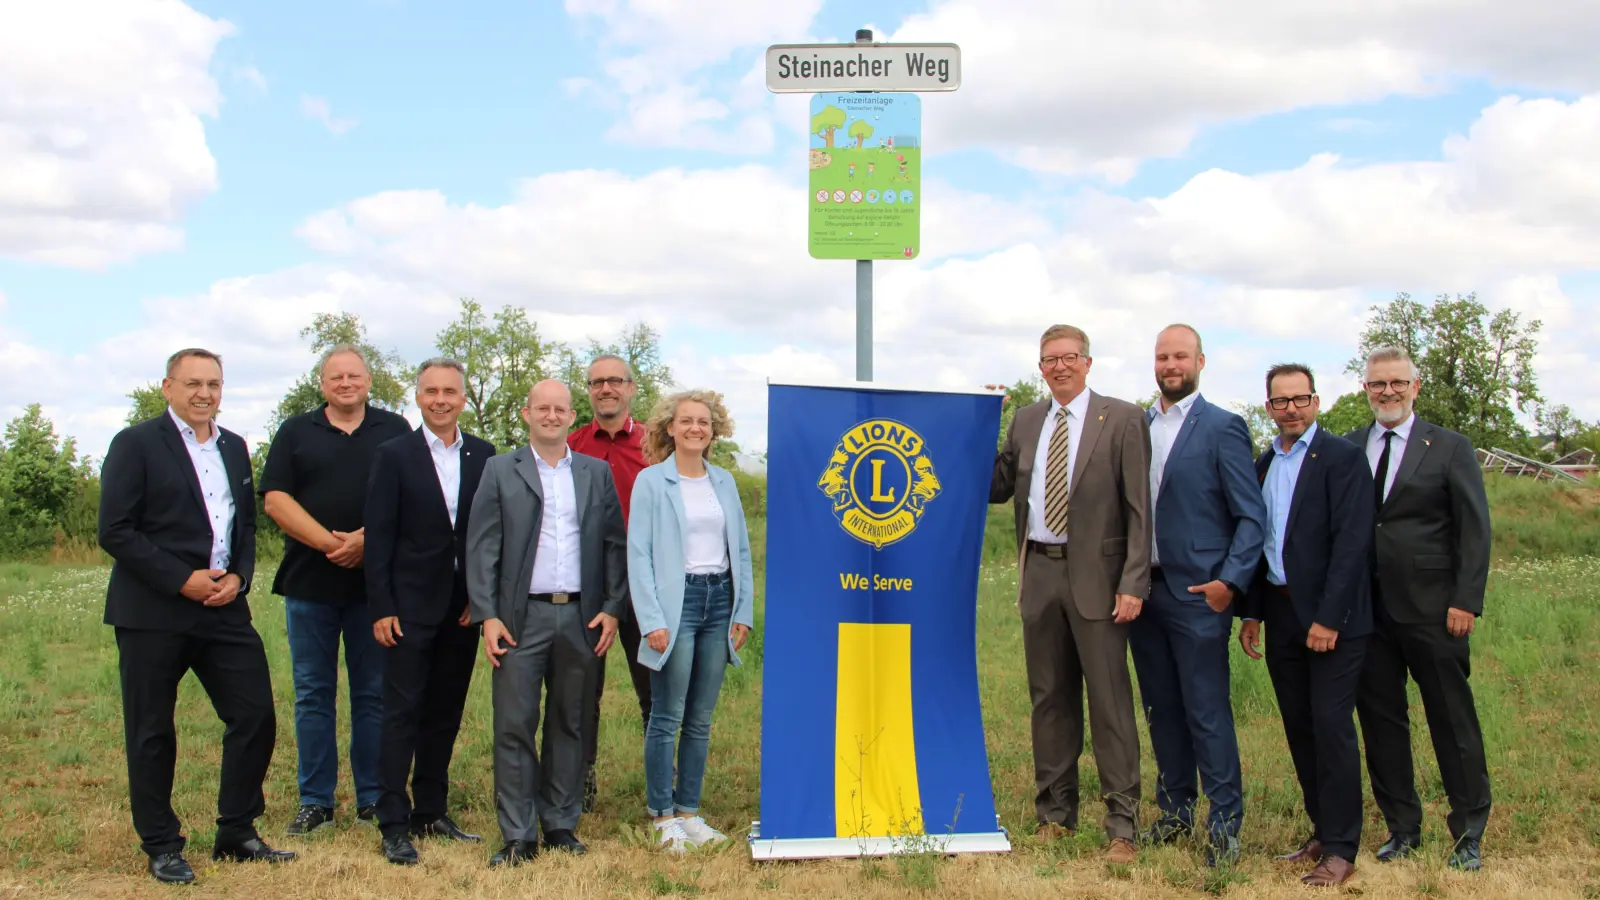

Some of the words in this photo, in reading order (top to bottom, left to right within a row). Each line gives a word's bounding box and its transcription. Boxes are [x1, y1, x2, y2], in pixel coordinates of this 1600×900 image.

[778, 53, 892, 78] Steinacher
[905, 52, 949, 83] Weg
[837, 96, 894, 106] Freizeitanlage
[848, 424, 919, 454] LIONS
[870, 459, 895, 503] L
[847, 513, 910, 539] INTERNATIONAL
[839, 572, 869, 590] We
[873, 573, 913, 591] Serve
